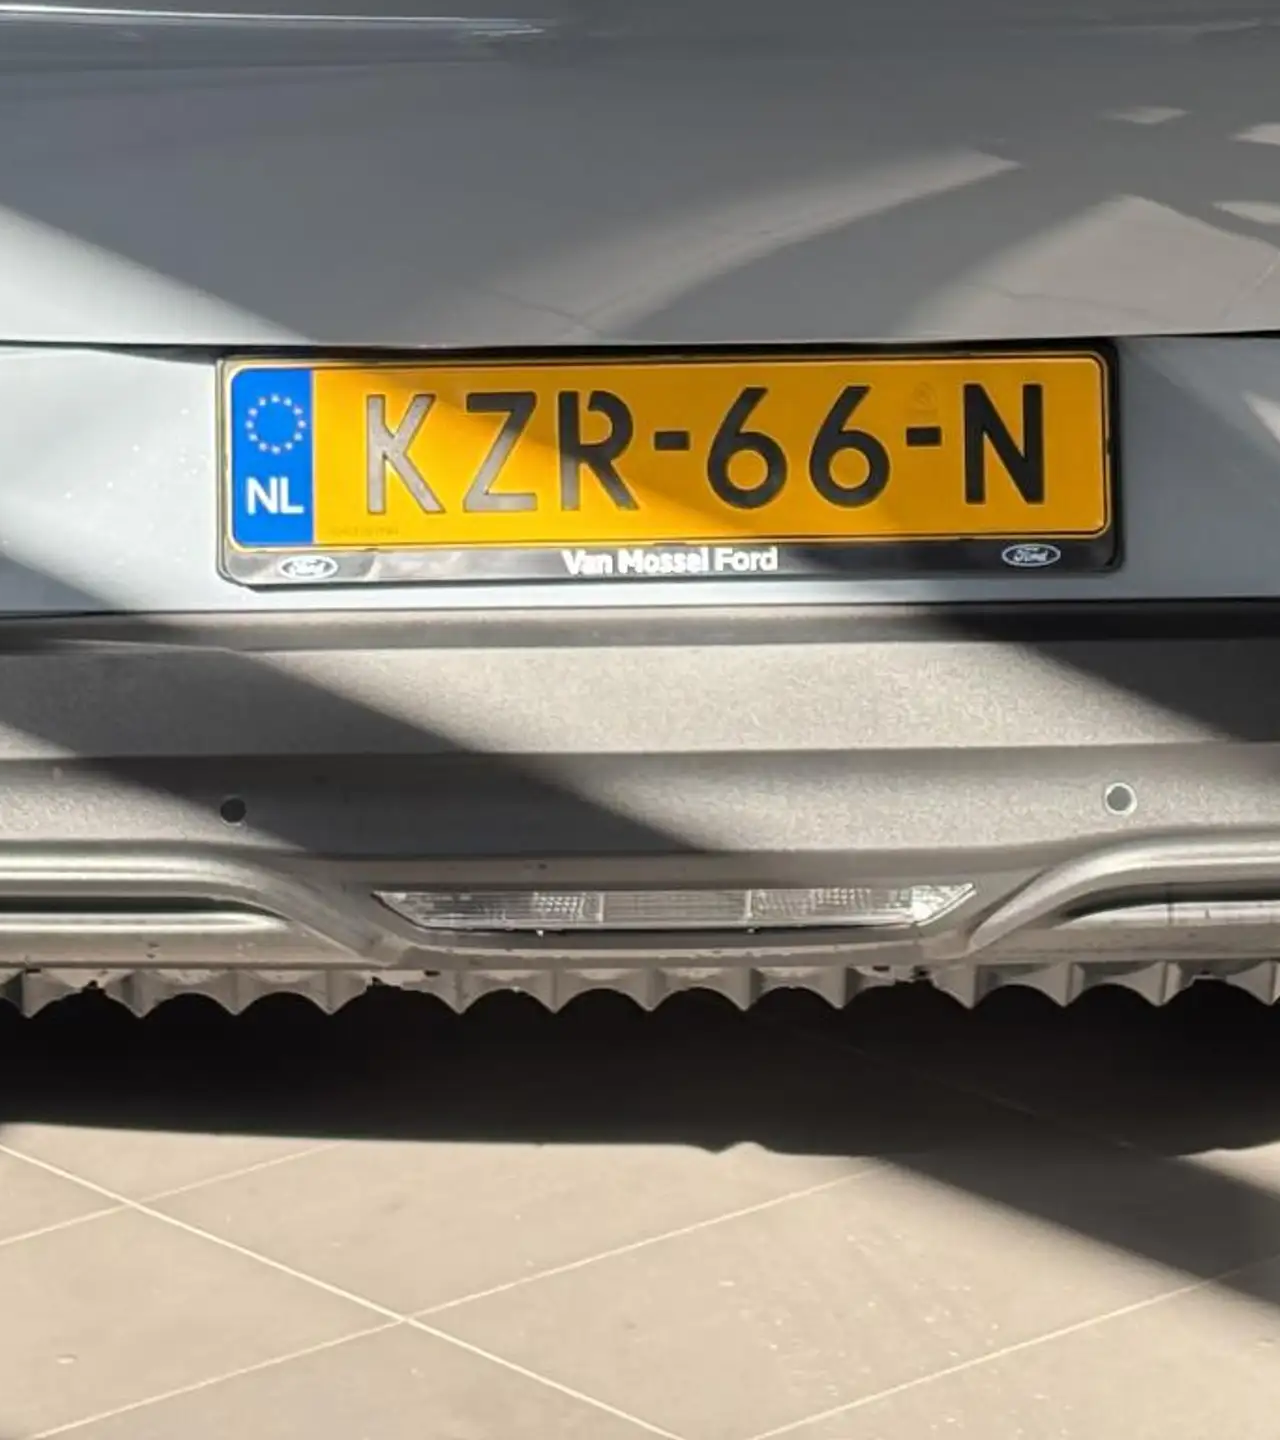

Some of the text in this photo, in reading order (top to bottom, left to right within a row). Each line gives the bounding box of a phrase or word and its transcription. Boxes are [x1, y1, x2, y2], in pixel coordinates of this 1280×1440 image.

[246, 383, 1046, 516] NL KZR-66-N
[561, 545, 779, 575] Van Mossel Ford
